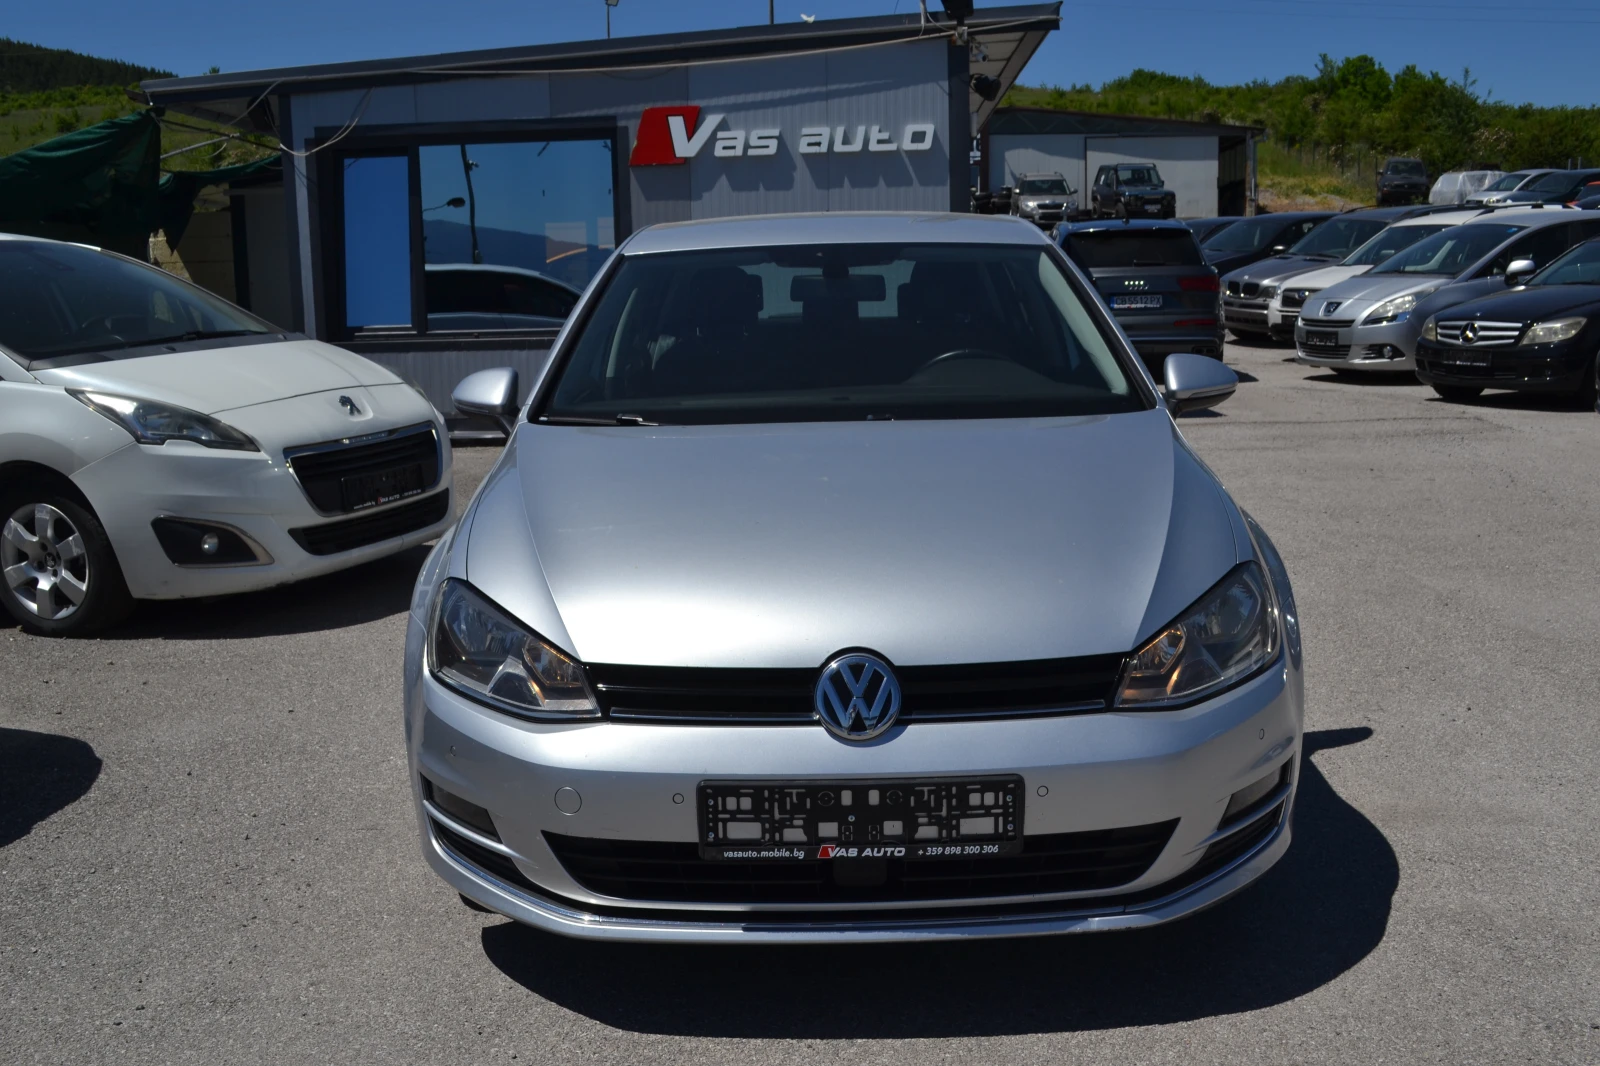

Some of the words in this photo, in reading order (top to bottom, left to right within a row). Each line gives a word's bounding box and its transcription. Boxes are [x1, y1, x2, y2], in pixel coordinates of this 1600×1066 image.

[798, 123, 936, 154] auto
[723, 847, 805, 860] vasauto.mobile.bg
[827, 846, 858, 858] VAS
[861, 846, 906, 857] AUTO
[944, 845, 962, 855] 898
[963, 845, 981, 854] 300
[981, 844, 999, 854] 306
